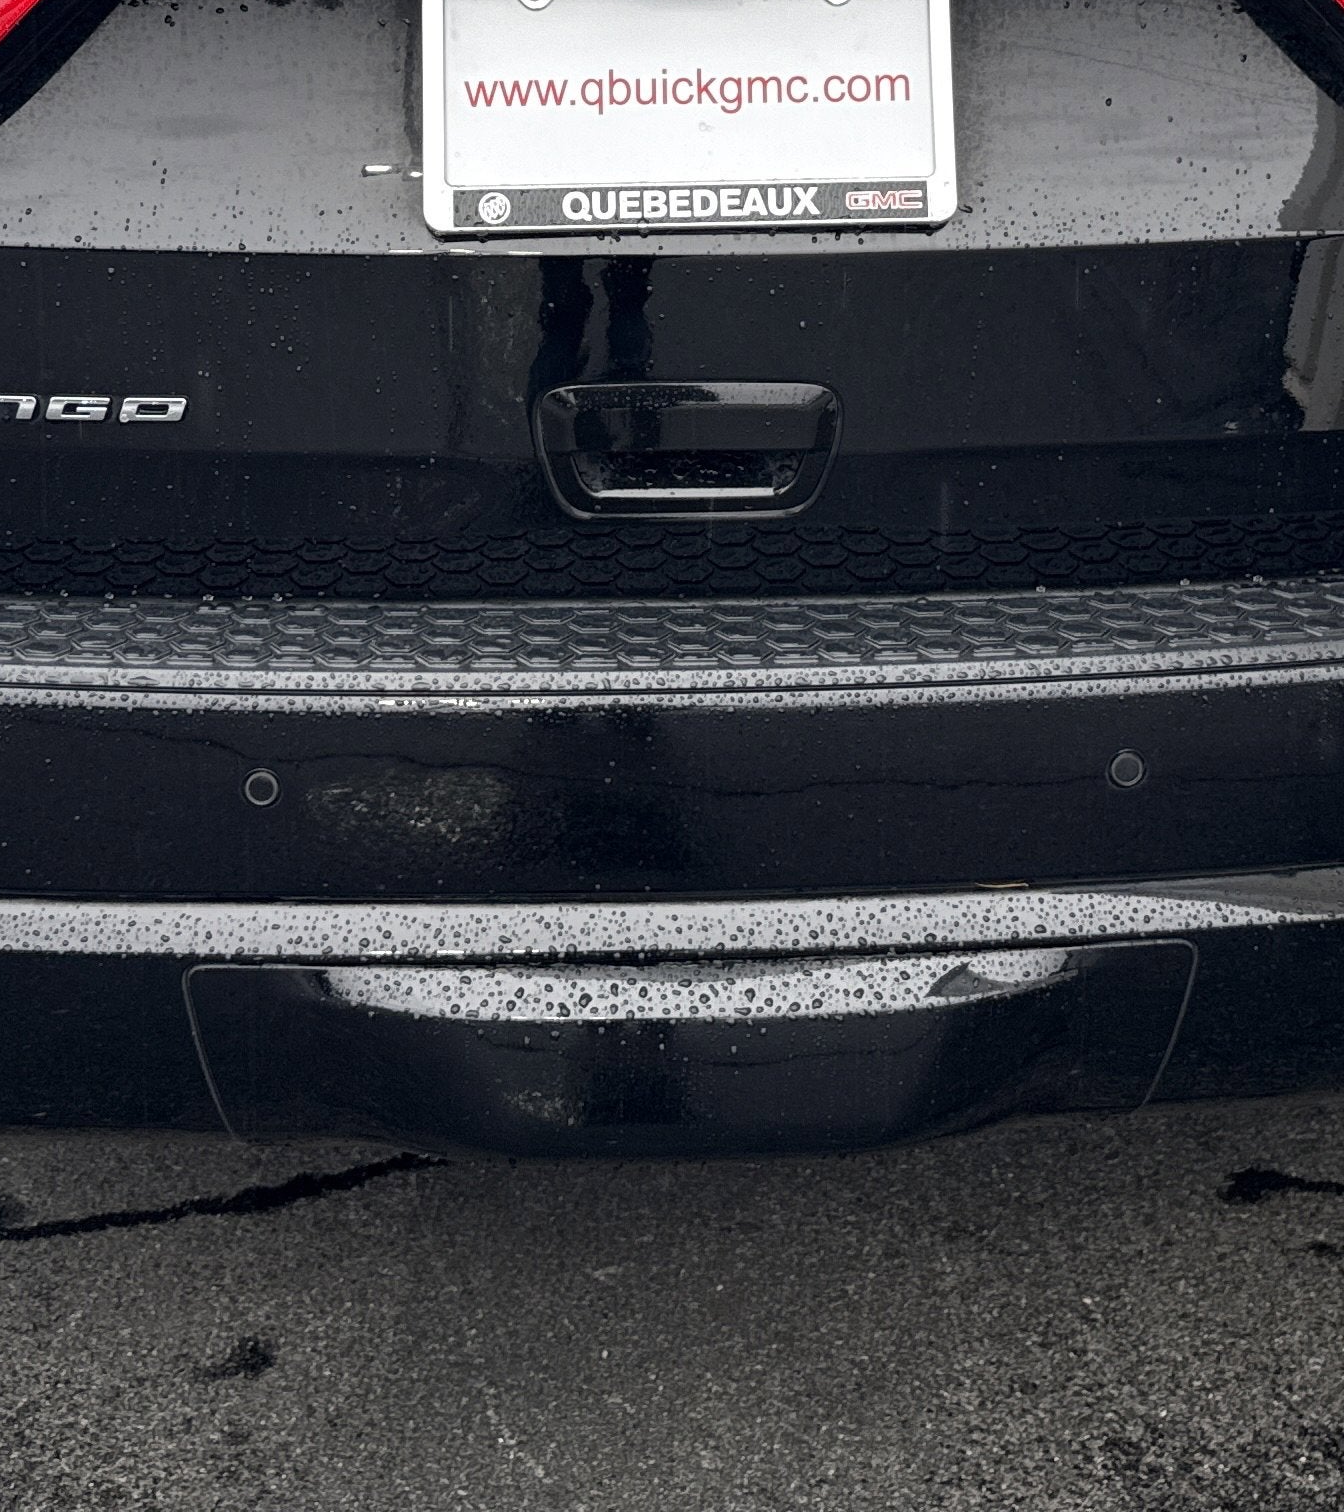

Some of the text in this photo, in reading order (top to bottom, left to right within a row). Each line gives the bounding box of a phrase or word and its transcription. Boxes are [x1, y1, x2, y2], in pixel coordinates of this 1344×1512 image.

[464, 67, 912, 116] www.qbuickgmc.com
[561, 185, 924, 222] QUEBEDEAUX GMC
